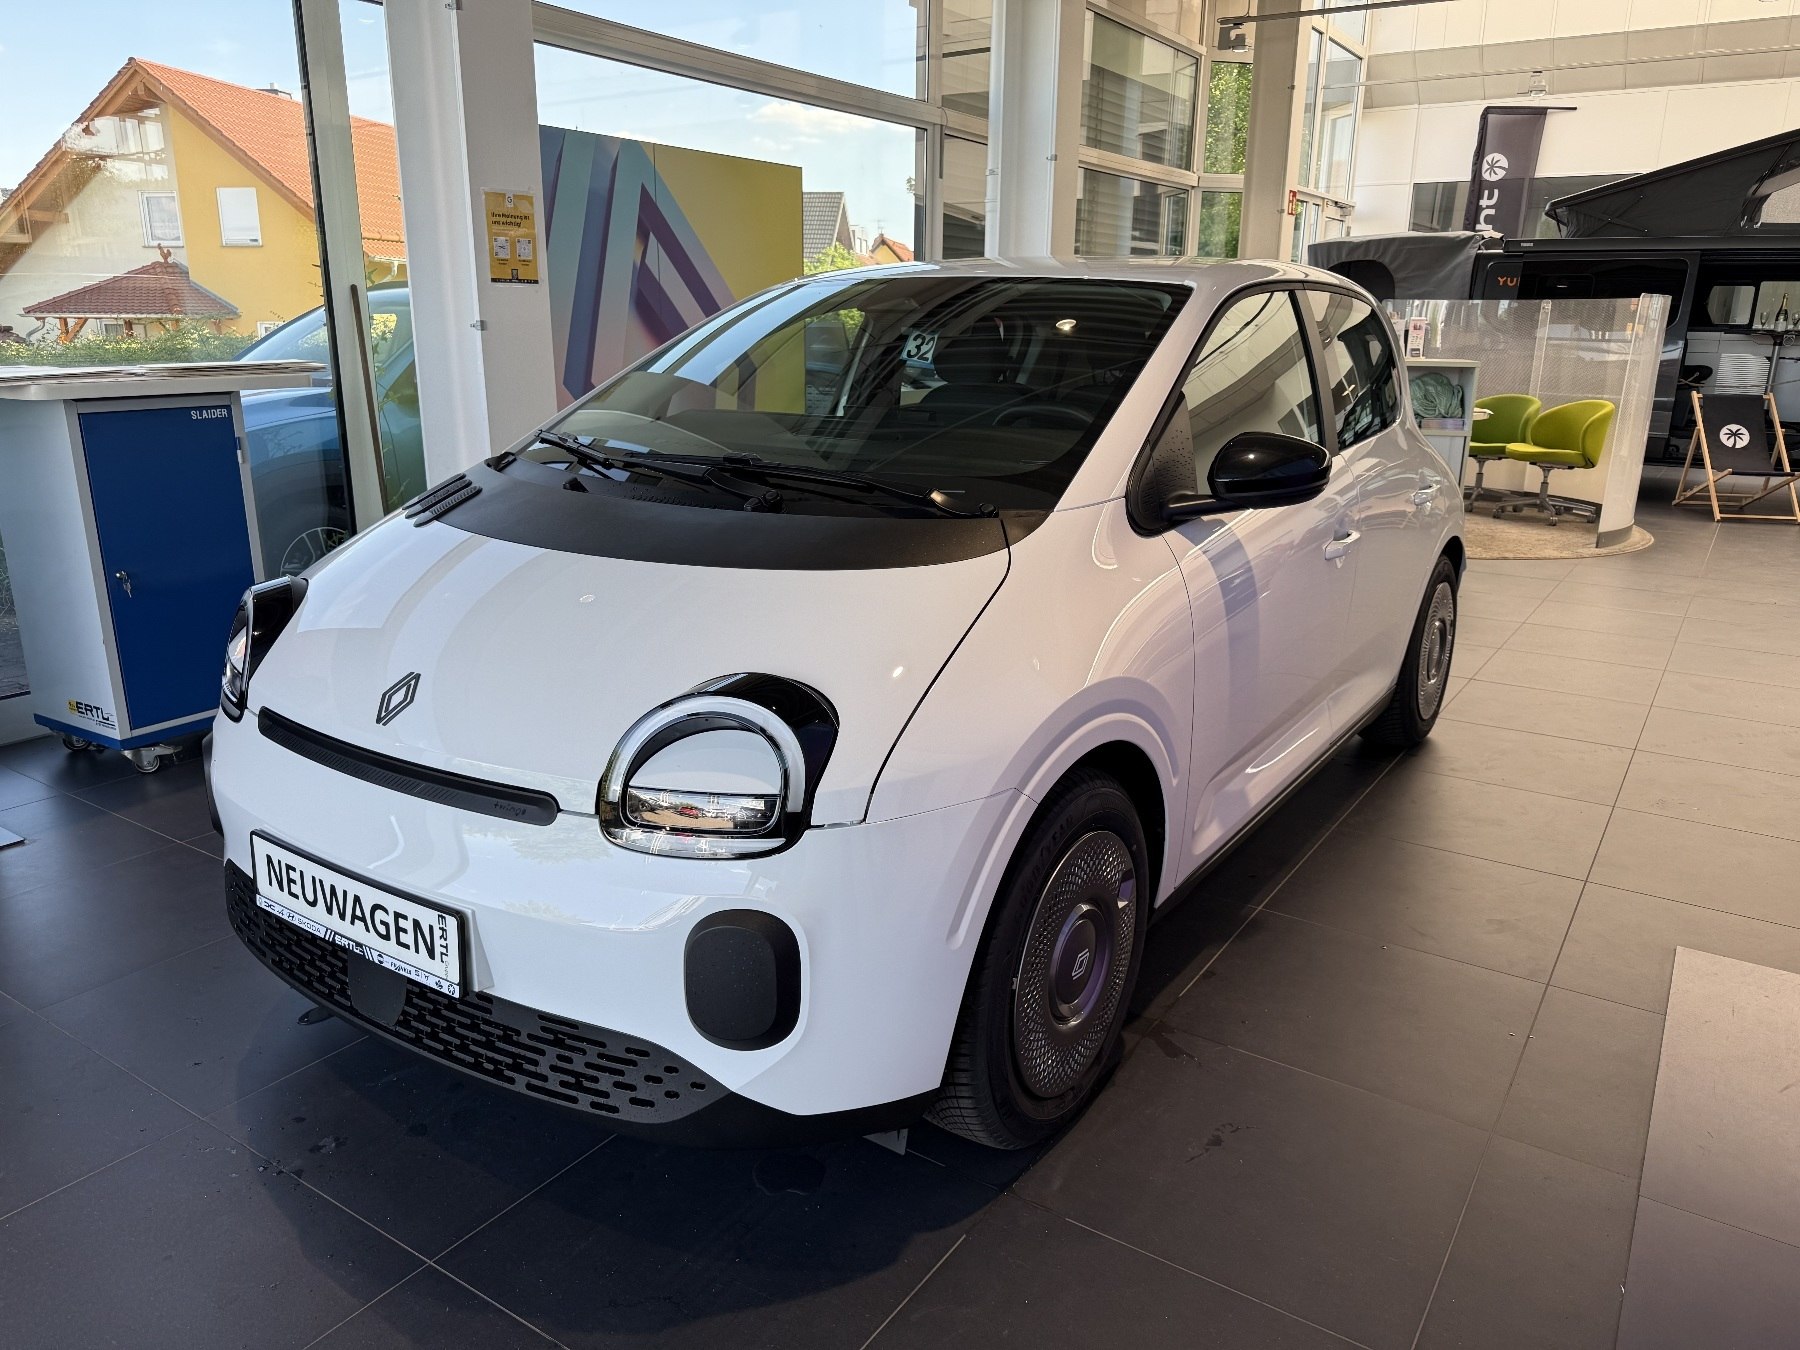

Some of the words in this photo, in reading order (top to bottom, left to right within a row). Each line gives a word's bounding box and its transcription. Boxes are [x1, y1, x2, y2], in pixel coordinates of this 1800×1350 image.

[1498, 276, 1520, 287] YU
[907, 333, 936, 361] 32
[191, 409, 228, 419] SLAIDER
[76, 701, 109, 721] ERTL
[266, 853, 436, 961] NEUWAGEN
[438, 914, 449, 963] ERTL
